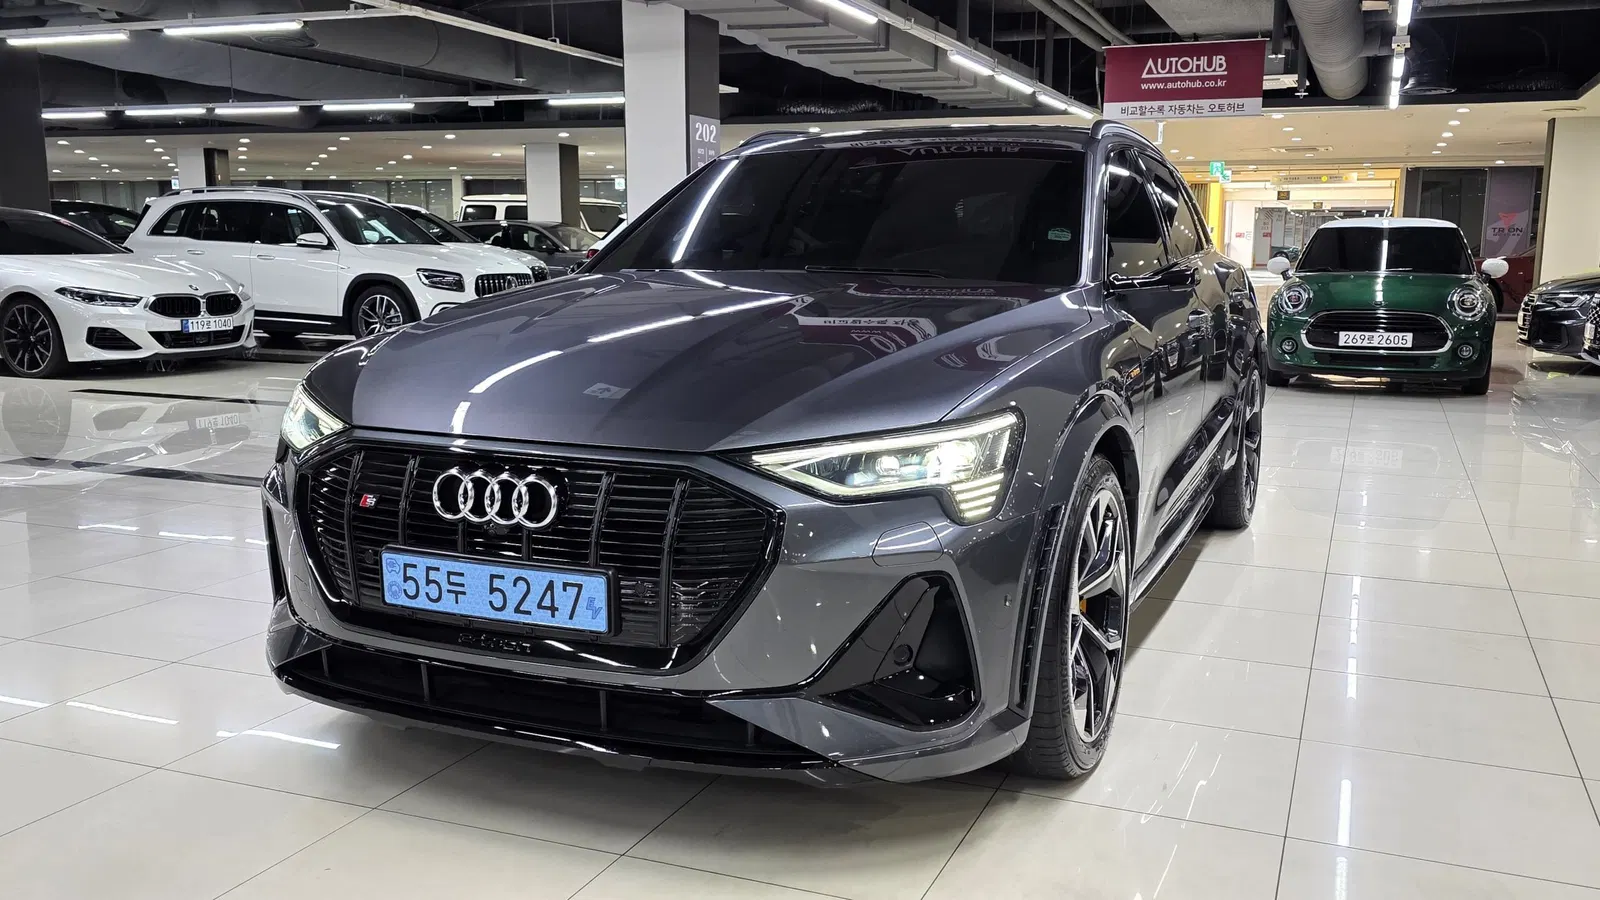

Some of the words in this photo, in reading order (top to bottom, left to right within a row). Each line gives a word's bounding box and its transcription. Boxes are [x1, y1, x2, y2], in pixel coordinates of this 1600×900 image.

[1141, 55, 1228, 78] AUTOHUB
[1141, 79, 1227, 90] www.autohub.co.kr
[1120, 104, 1165, 117] 비교할수록
[1167, 103, 1205, 116] 자동차는
[1207, 102, 1246, 113] 오토허브
[695, 122, 717, 143] 202
[213, 318, 232, 329] 1040
[1343, 333, 1375, 345] 269로
[1377, 334, 1408, 345] 2605
[402, 562, 467, 604] 55두
[488, 573, 584, 621] 5247
[585, 596, 603, 620] EV
